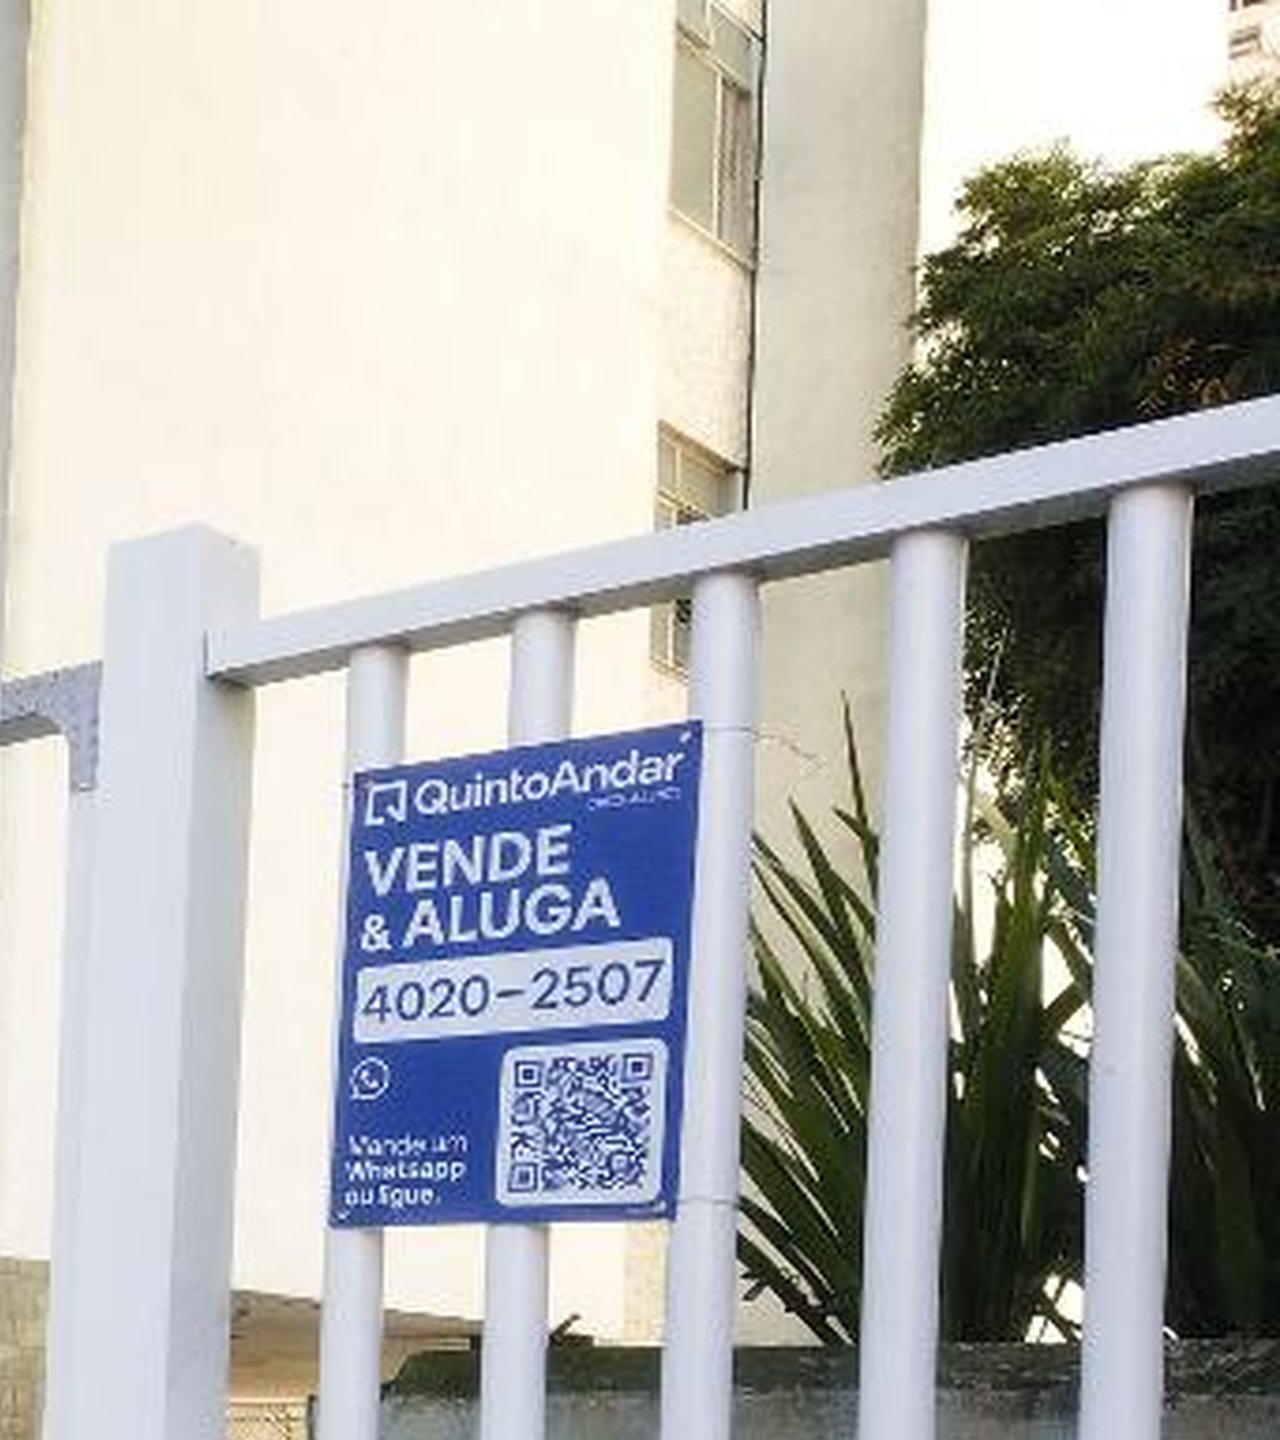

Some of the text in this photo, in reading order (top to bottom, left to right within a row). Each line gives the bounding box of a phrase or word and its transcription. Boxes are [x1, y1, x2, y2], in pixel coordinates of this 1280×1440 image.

[414, 748, 685, 815] QuintoAndar
[363, 824, 573, 897] VENDE
[360, 876, 621, 951] & ALUGA
[362, 959, 666, 1023] 4020-2507
[344, 1188, 375, 1206] ou
